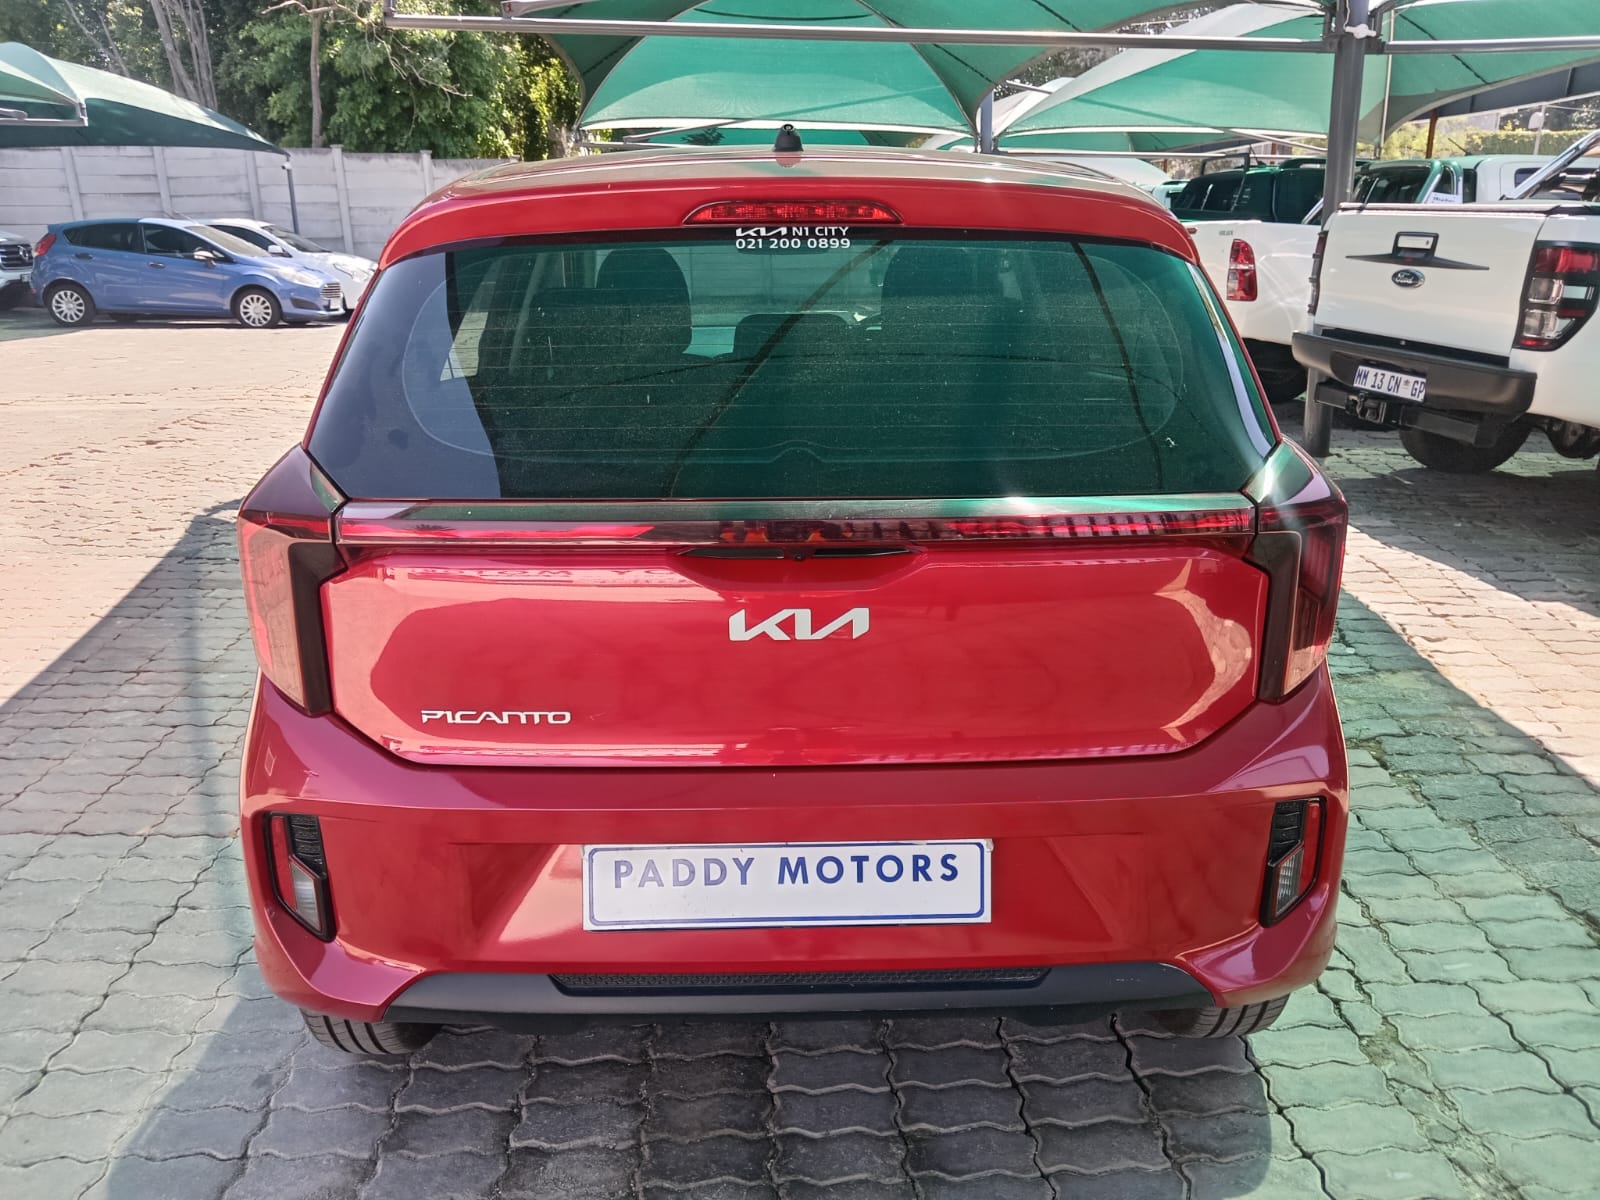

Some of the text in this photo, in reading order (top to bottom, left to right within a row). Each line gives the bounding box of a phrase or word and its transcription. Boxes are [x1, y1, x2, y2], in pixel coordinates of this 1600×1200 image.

[735, 226, 849, 237] KIA N1 CITY
[735, 238, 851, 249] 021 200 0899
[1370, 371, 1386, 390] 13
[1387, 375, 1402, 393] CN
[1410, 380, 1425, 399] GP
[728, 607, 870, 642] KIA
[420, 709, 572, 725] PICANTO
[613, 853, 960, 889] PADDY MOTORS
